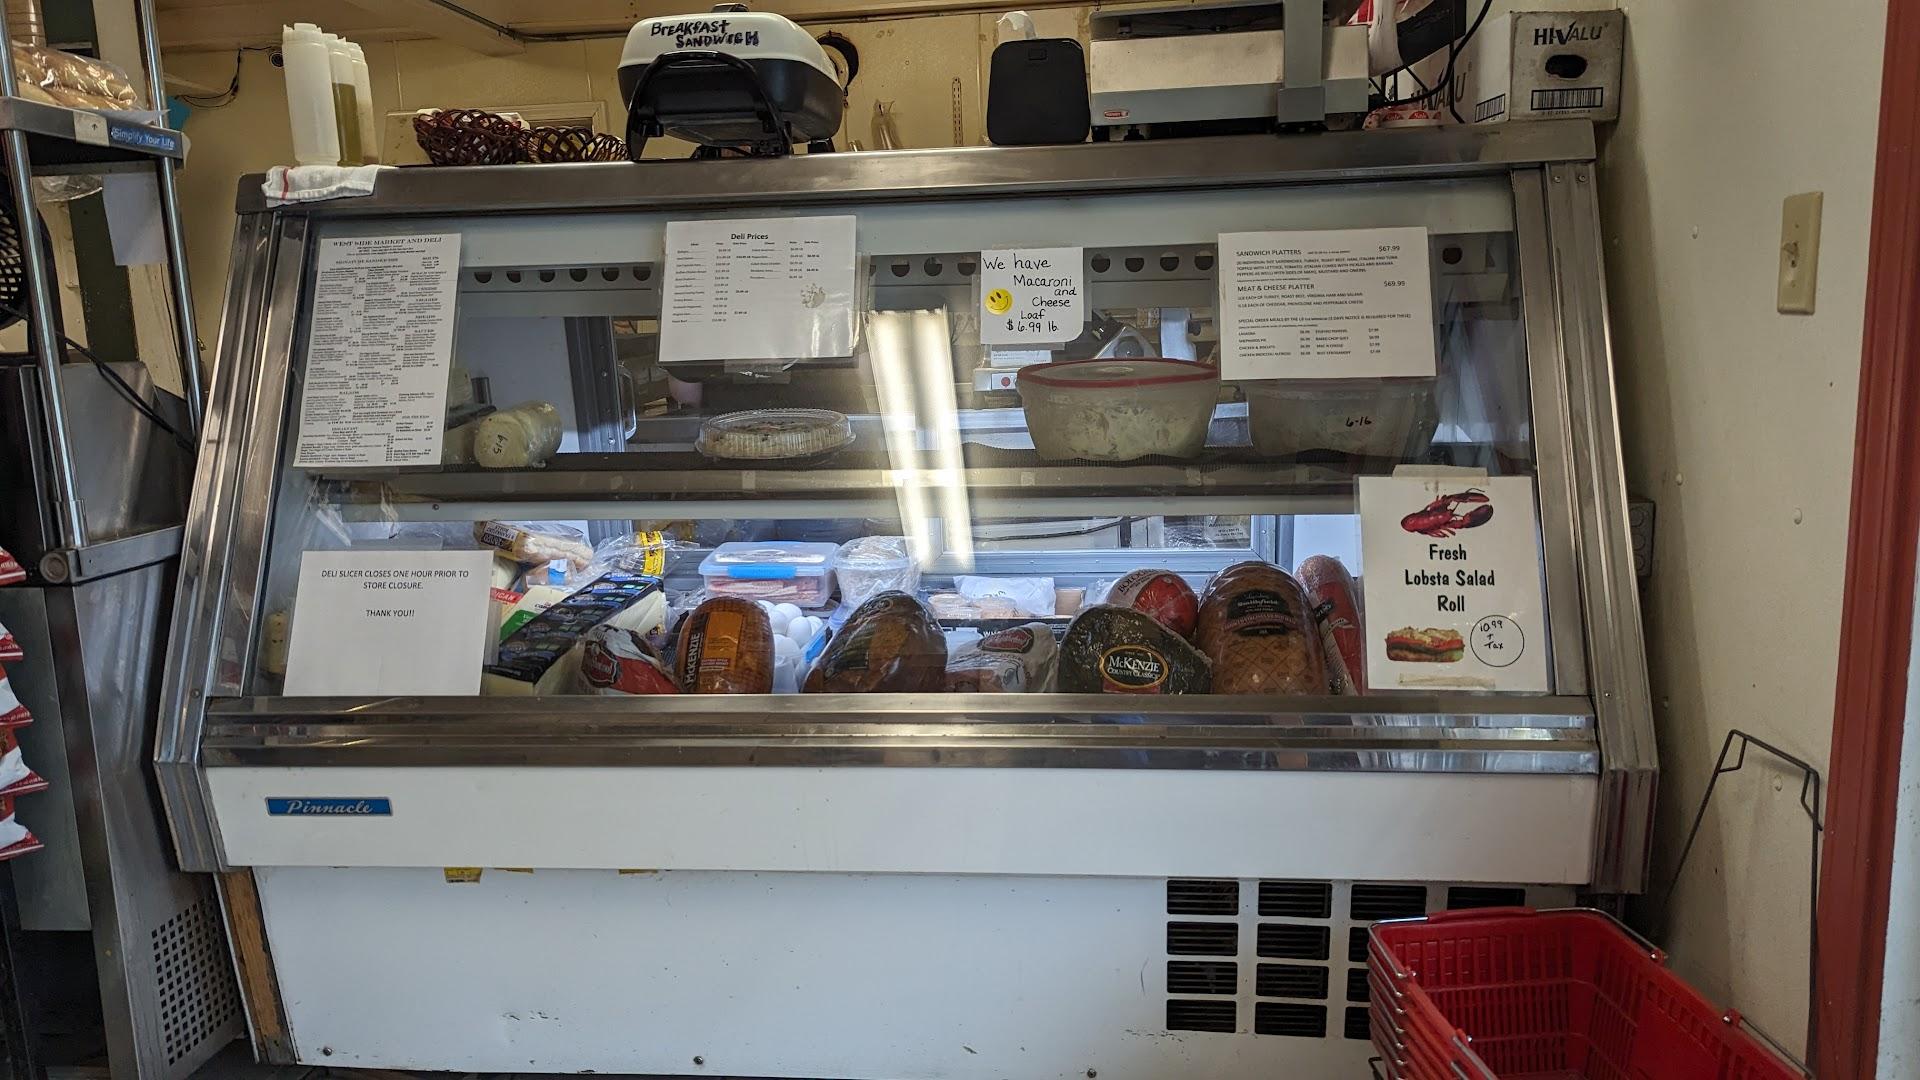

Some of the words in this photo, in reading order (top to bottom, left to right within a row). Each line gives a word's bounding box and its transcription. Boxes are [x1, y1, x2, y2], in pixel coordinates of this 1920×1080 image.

[145, 134, 160, 144] Your
[162, 138, 175, 148] Life
[983, 257, 1005, 269] We
[1014, 253, 1051, 270] have
[1014, 274, 1072, 286] Macaroni
[1054, 287, 1077, 296] and
[1032, 296, 1071, 307] Cheese
[1020, 309, 1046, 319] Loaf
[1346, 416, 1372, 427] 6-16
[1429, 544, 1466, 560] Fresh
[1405, 569, 1449, 586] Lobsta
[1455, 570, 1495, 586] Salad
[1437, 596, 1464, 612] Roll
[1484, 641, 1503, 650] Tax
[287, 800, 373, 814] Pinnacle
